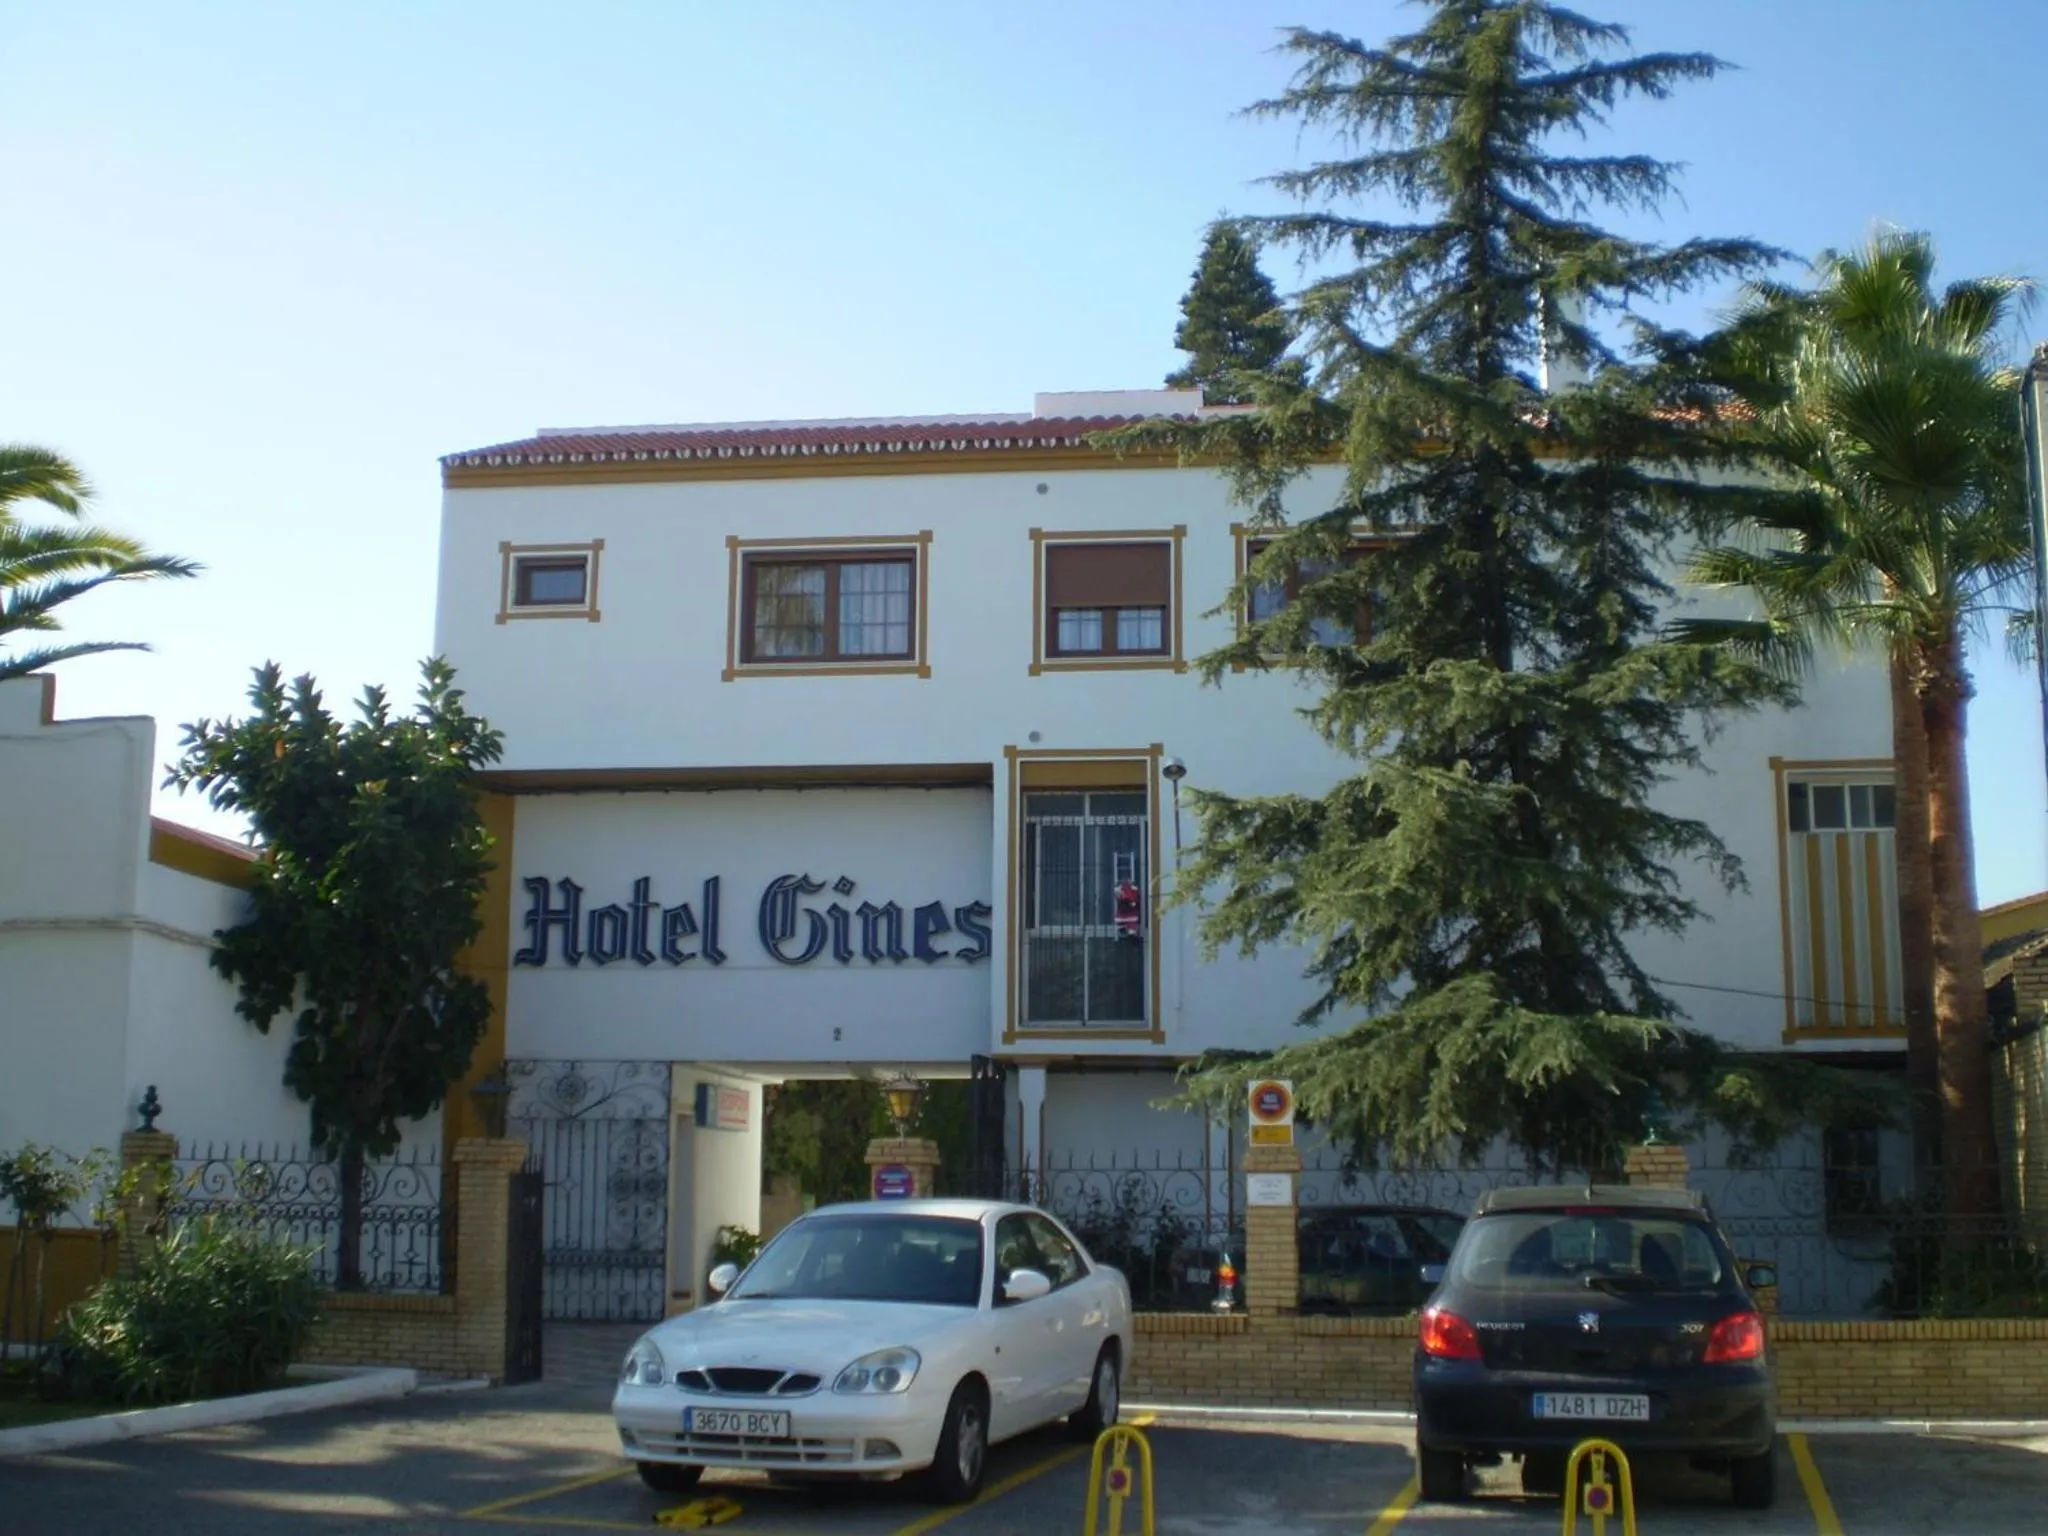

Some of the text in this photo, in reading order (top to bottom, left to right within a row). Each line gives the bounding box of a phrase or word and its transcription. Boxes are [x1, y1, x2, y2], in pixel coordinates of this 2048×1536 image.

[514, 873, 992, 967] Hotel Gines
[1549, 1396, 1642, 1417] 1481 DZH
[696, 1412, 780, 1433] 3670 BCY
